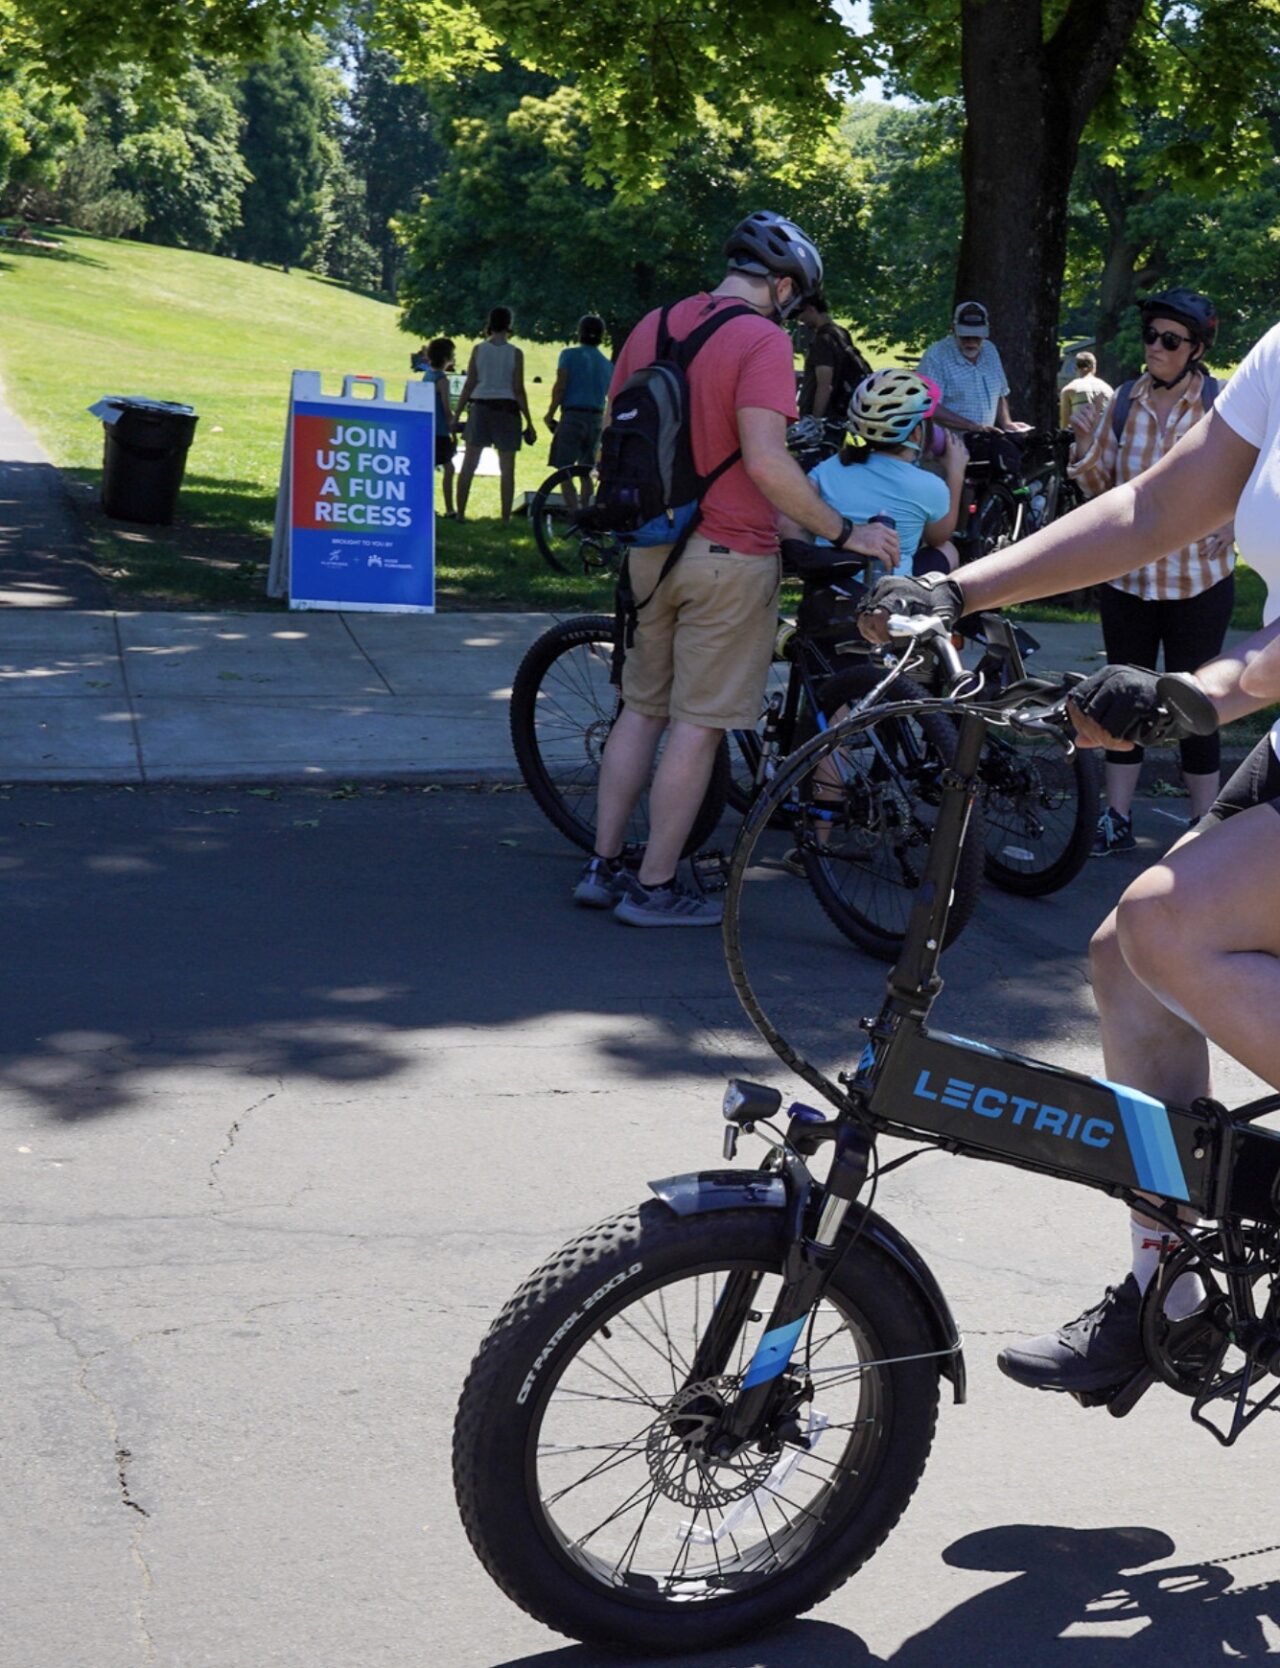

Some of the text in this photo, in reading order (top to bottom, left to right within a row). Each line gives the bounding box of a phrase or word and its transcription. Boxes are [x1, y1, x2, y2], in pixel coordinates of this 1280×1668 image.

[329, 425, 397, 449] JOIN
[316, 450, 411, 476] US FOR
[319, 476, 406, 501] A FUN
[315, 501, 412, 527] RECESS
[912, 1070, 1115, 1149] LECTRIC
[517, 1262, 642, 1404] CST PATROL 20X3.0
